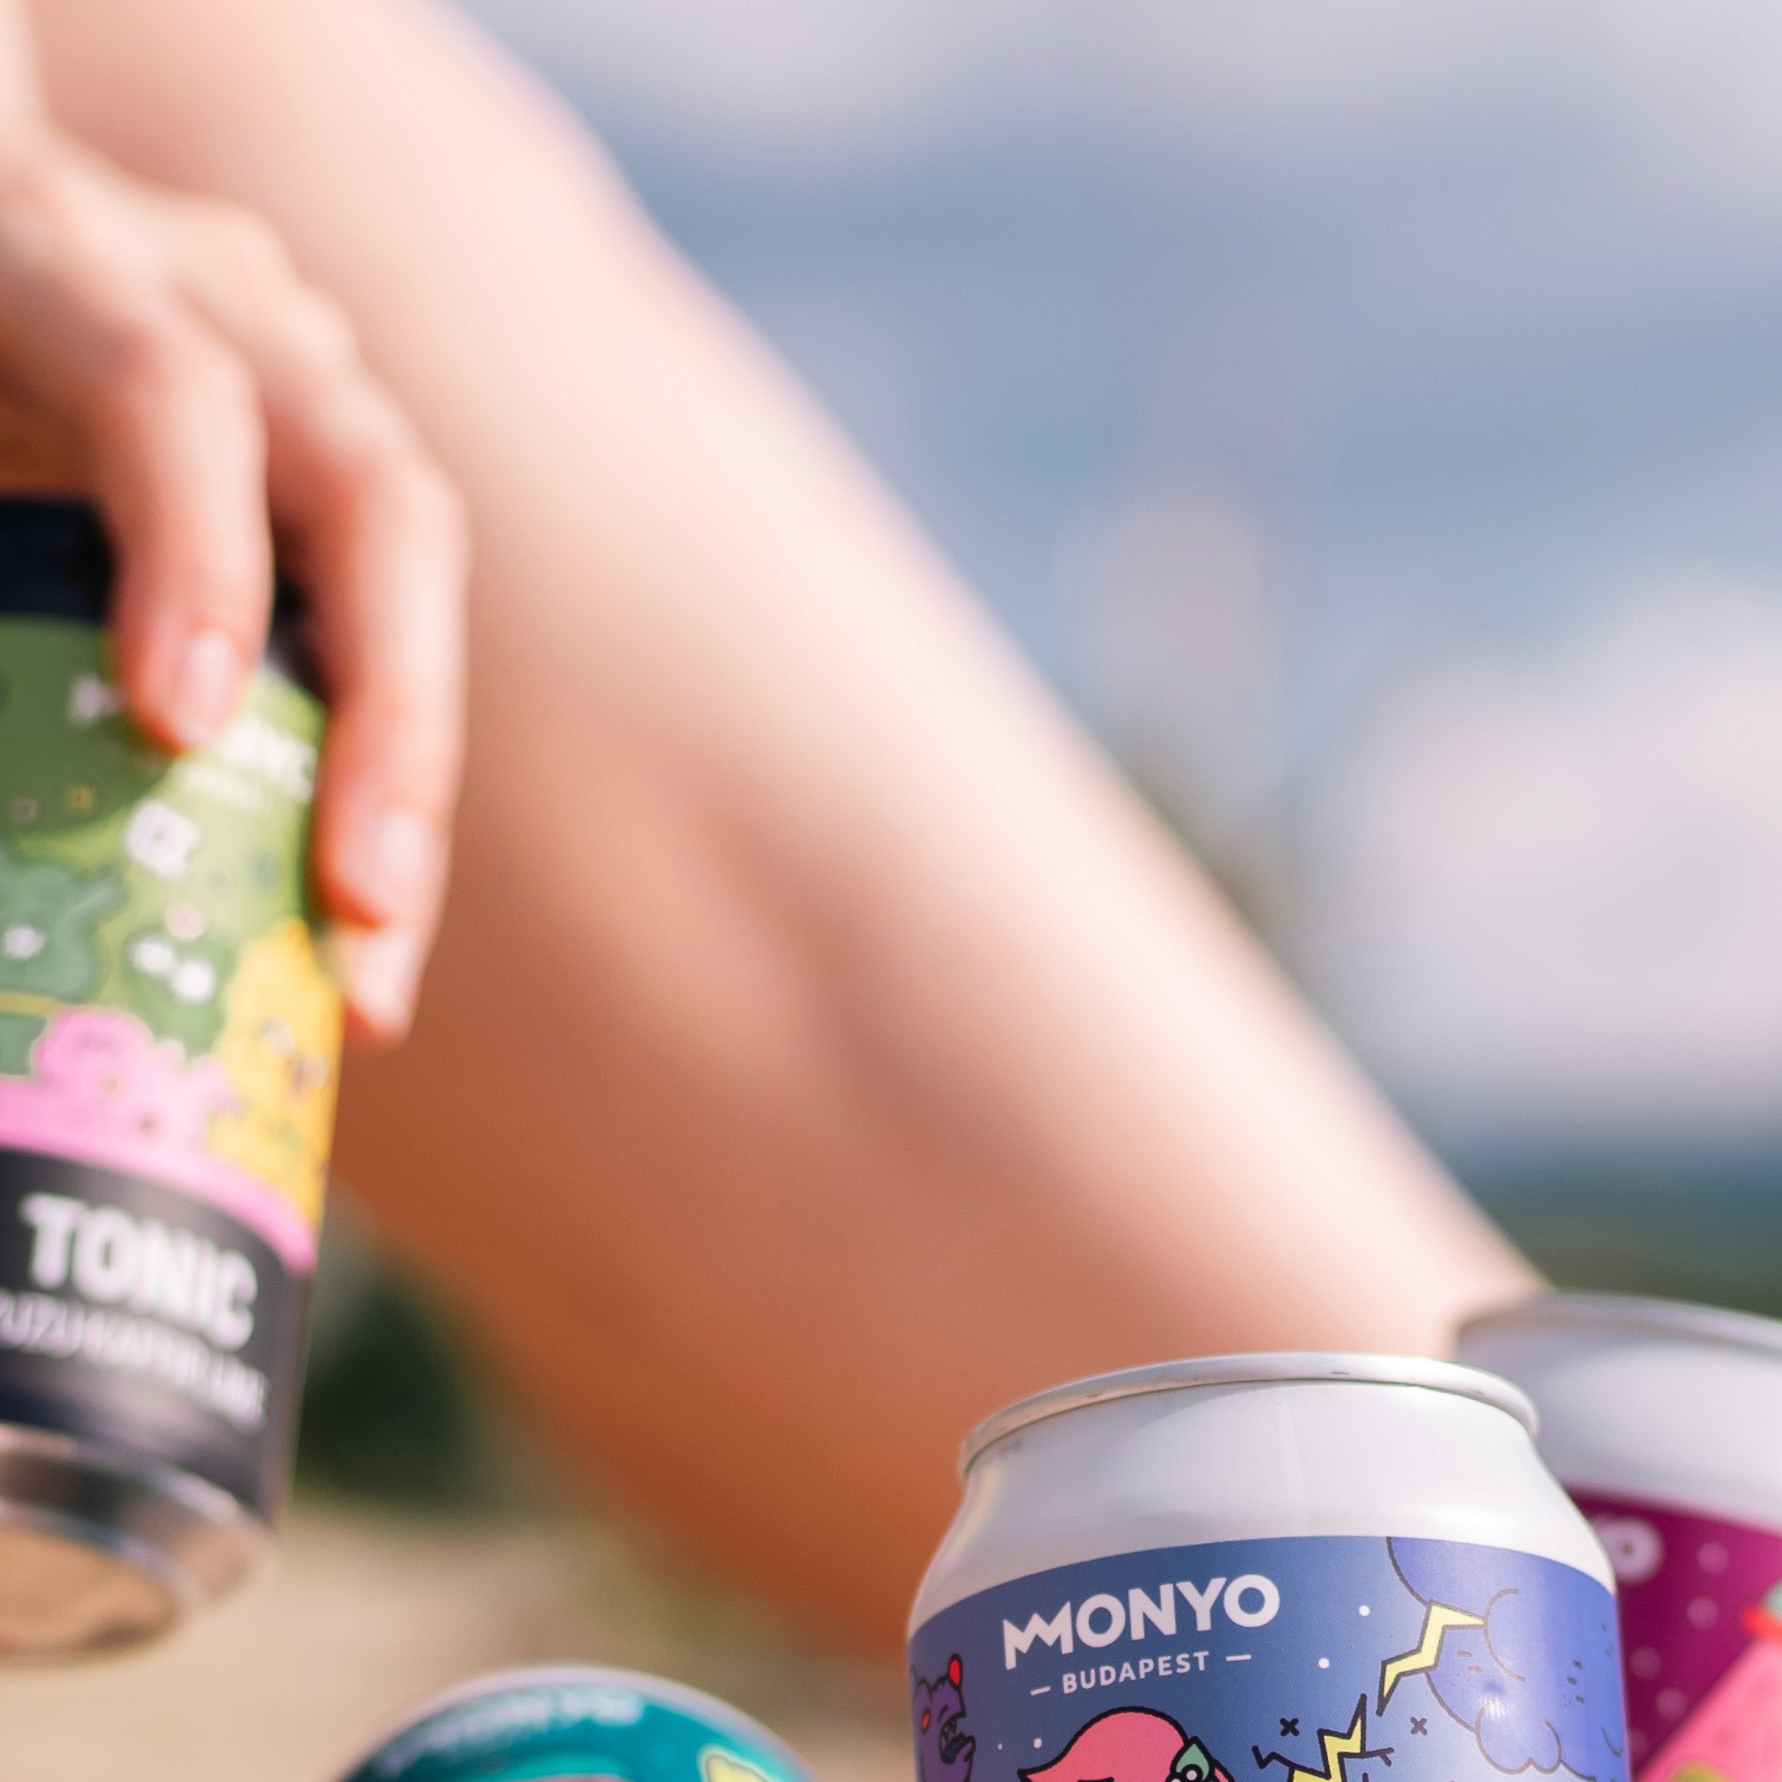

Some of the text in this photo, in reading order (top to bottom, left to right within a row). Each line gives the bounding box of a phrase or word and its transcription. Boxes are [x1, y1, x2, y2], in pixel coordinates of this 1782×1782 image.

[23, 1193, 256, 1349] TONIC
[1003, 1574, 1280, 1670] MONYO
[1062, 1651, 1209, 1694] BUDAPEST
